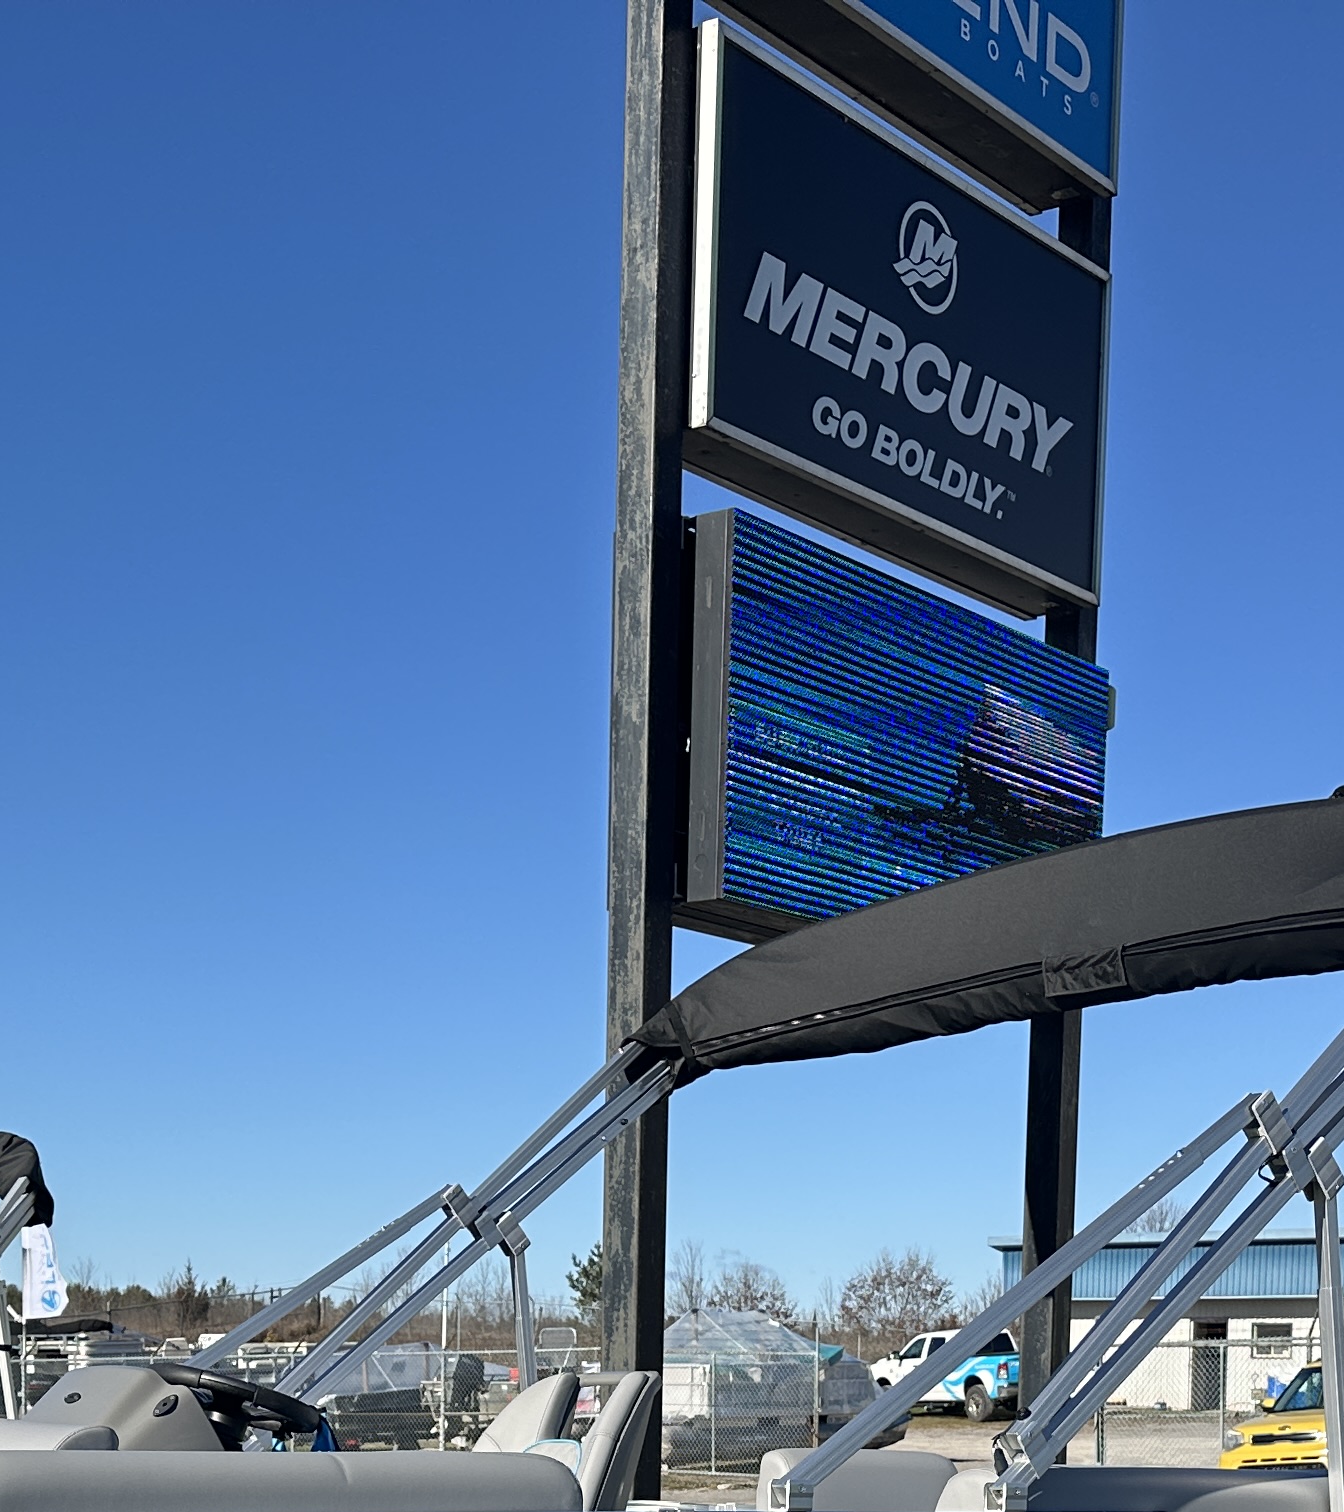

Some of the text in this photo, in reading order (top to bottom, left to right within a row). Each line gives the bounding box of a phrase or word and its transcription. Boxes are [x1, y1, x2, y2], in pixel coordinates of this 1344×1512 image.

[961, 18, 1072, 115] BOATS
[743, 251, 1074, 473] MERCURY
[812, 396, 868, 449] GO
